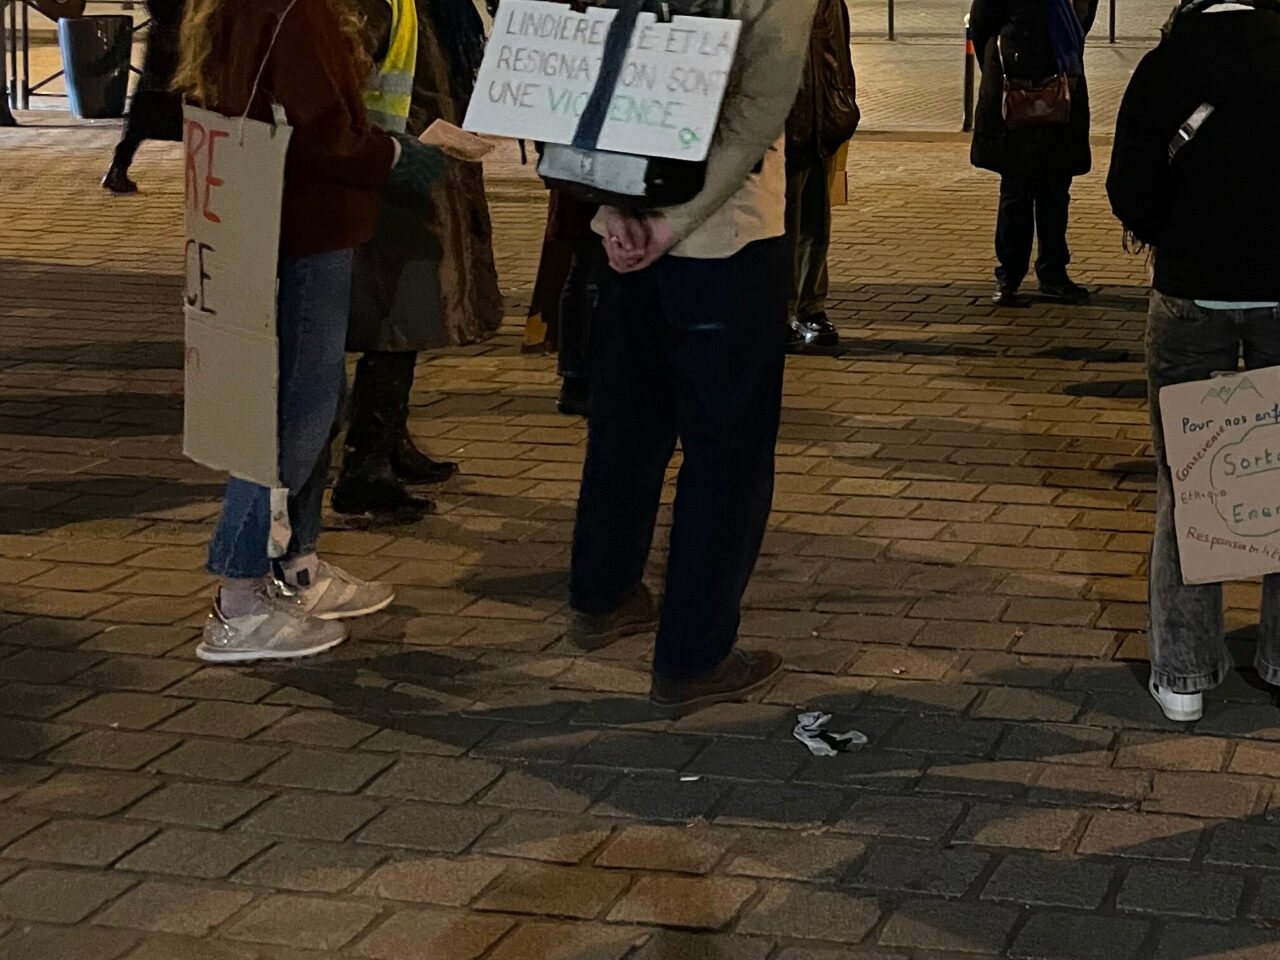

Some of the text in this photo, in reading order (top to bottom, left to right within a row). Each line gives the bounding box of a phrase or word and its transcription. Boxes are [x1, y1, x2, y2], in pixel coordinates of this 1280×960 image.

[488, 80, 688, 129] UNE VIOENCE
[1181, 416, 1214, 434] Pour
[1224, 414, 1248, 427] nos
